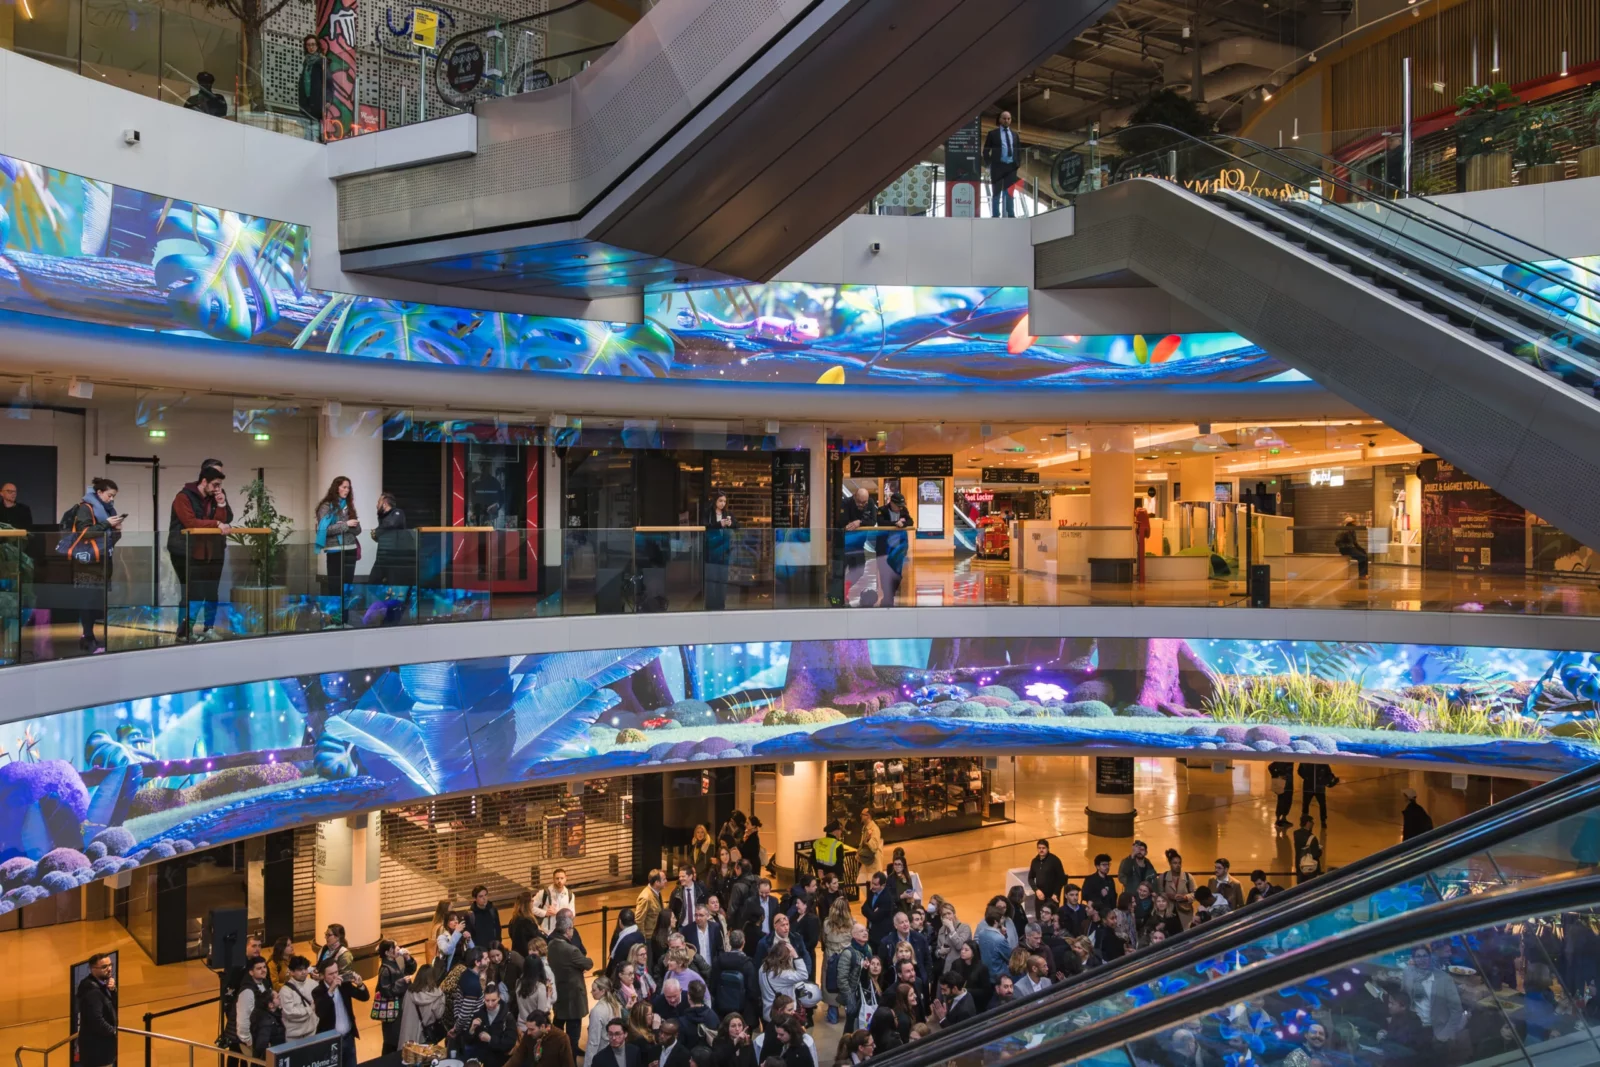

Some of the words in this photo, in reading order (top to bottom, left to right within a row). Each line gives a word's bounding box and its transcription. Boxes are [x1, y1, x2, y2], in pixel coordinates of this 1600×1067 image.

[853, 460, 862, 473] 2
[984, 470, 990, 480] 2
[1443, 482, 1463, 491] GAGNEZ
[965, 493, 976, 501] Foot
[976, 492, 994, 501] Locker
